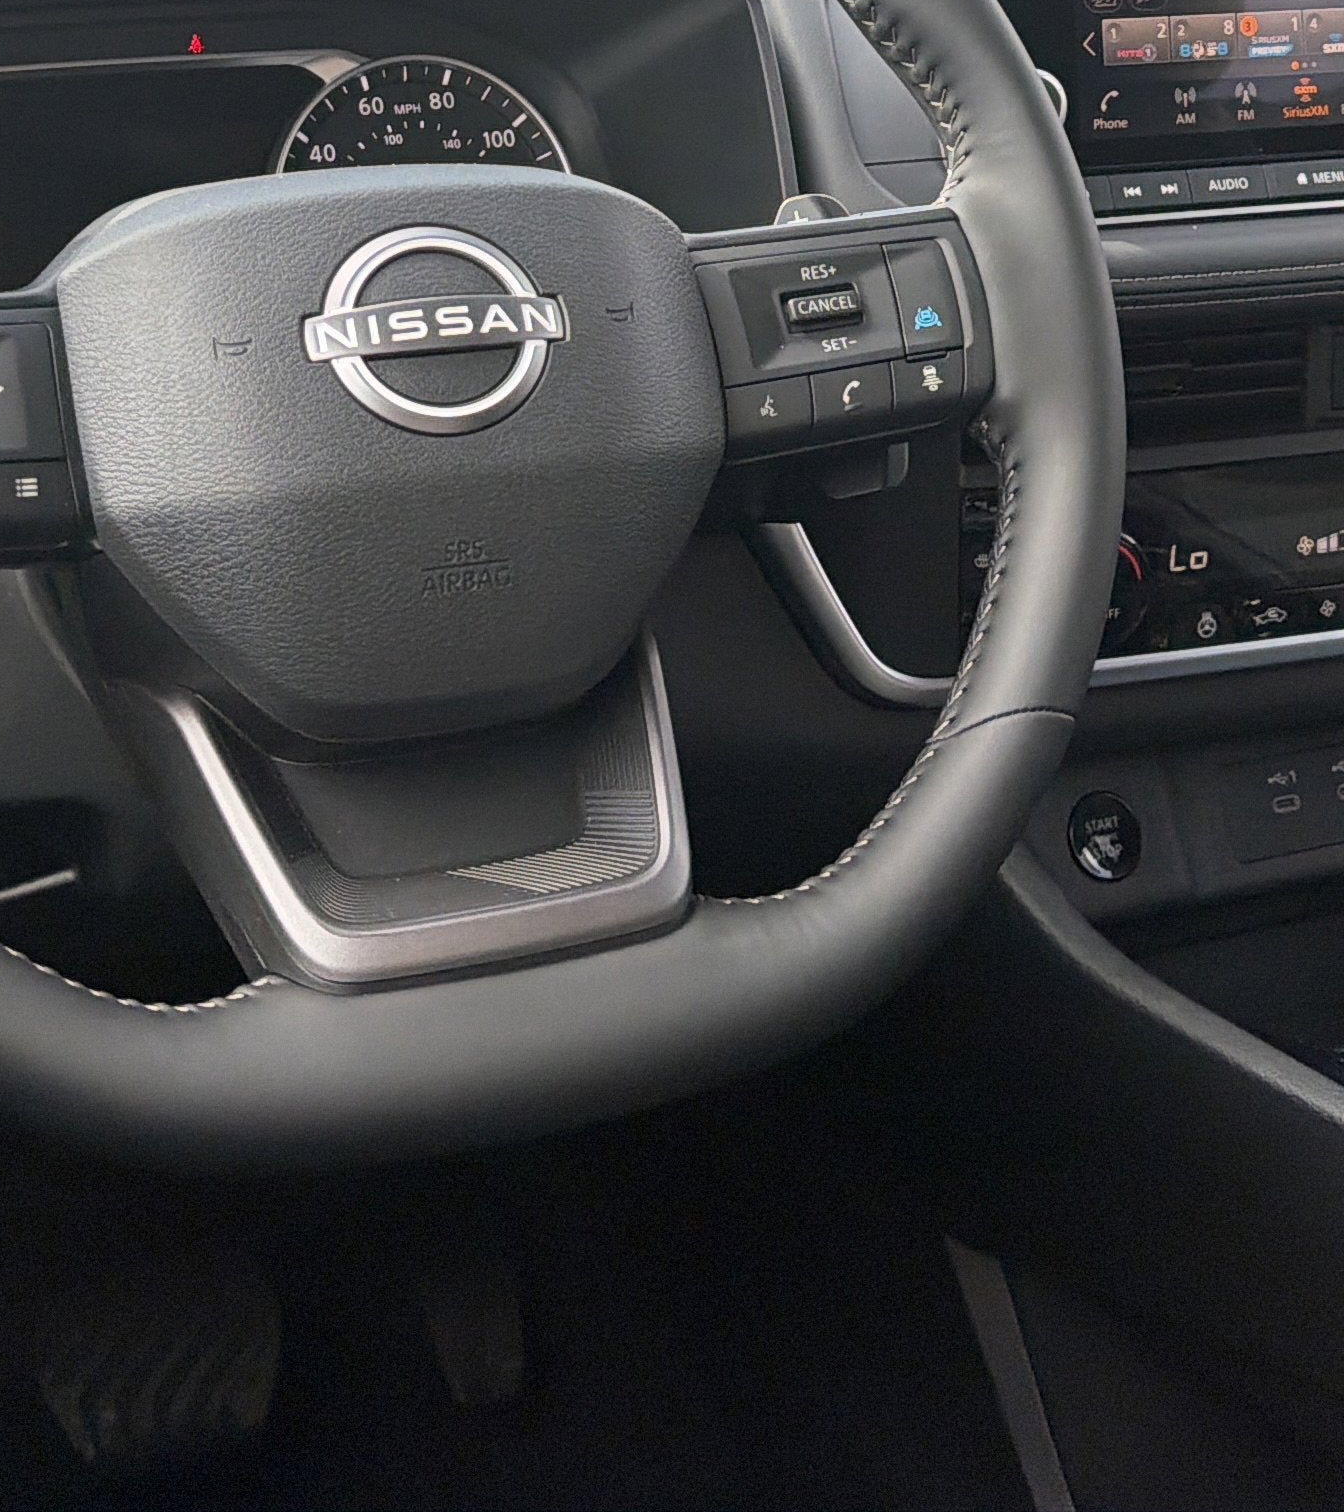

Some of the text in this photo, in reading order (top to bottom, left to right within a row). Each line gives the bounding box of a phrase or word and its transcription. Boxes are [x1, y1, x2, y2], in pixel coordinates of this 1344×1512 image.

[1156, 23, 1168, 39] 2
[1176, 24, 1186, 37] 2
[1223, 19, 1235, 36] 8
[1290, 16, 1299, 32] 1
[1308, 17, 1318, 30] 4
[1110, 27, 1118, 40] 1
[358, 95, 385, 117] 60
[428, 90, 455, 111] 80
[394, 102, 422, 116] MPH
[1237, 109, 1255, 122] FM
[1282, 103, 1330, 120] SiriusXM
[1093, 117, 1129, 131] Phone
[1175, 113, 1196, 125] AM
[383, 133, 404, 147] 100
[442, 138, 462, 151] 140
[483, 128, 516, 149] 100
[309, 143, 337, 164] 40
[1208, 176, 1249, 193] AUDIO
[800, 264, 838, 282] RES+
[797, 295, 857, 316] CANCEL
[314, 302, 558, 354] NISSAN
[1169, 543, 1209, 573] Lo
